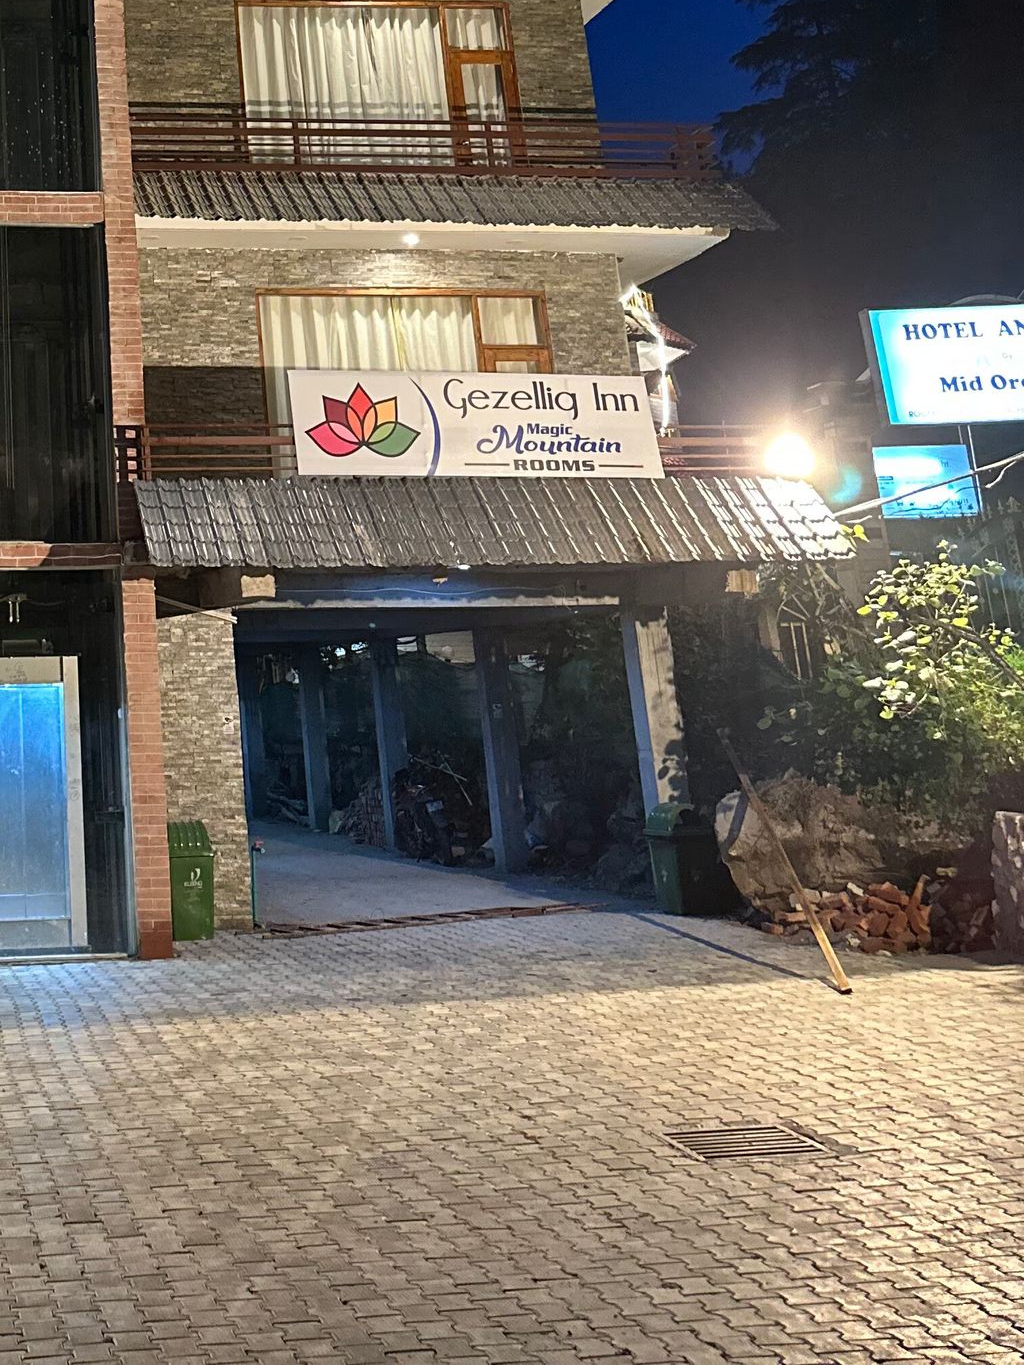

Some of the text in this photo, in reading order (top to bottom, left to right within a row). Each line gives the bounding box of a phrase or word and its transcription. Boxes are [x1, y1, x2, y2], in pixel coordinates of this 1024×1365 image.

[902, 321, 983, 341] HOTEL
[939, 376, 983, 392] Mid
[443, 378, 640, 420] Gezellig Inn
[476, 424, 622, 455] Mountain
[527, 423, 573, 438] Magic
[514, 459, 595, 472] ROOMS
